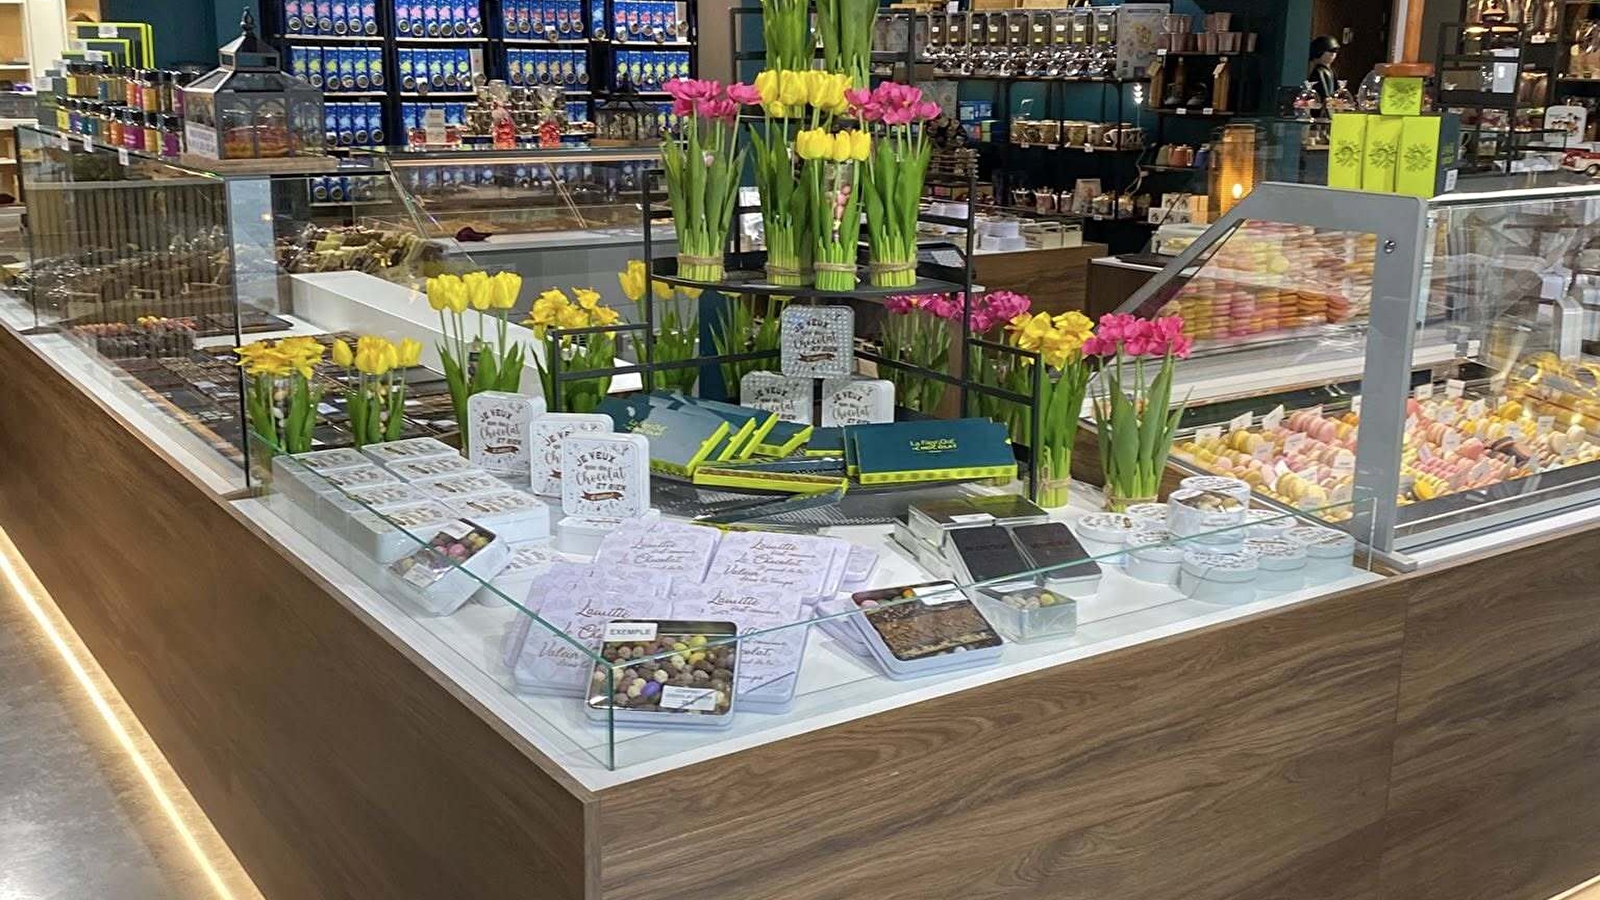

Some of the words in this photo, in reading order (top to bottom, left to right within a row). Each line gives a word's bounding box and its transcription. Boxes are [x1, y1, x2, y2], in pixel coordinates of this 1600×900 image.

[576, 453, 589, 467] JE
[588, 450, 617, 463] VEUX
[575, 466, 626, 486] Chocolat
[752, 553, 805, 567] Chocolat
[609, 628, 652, 636] EXEMPLE
